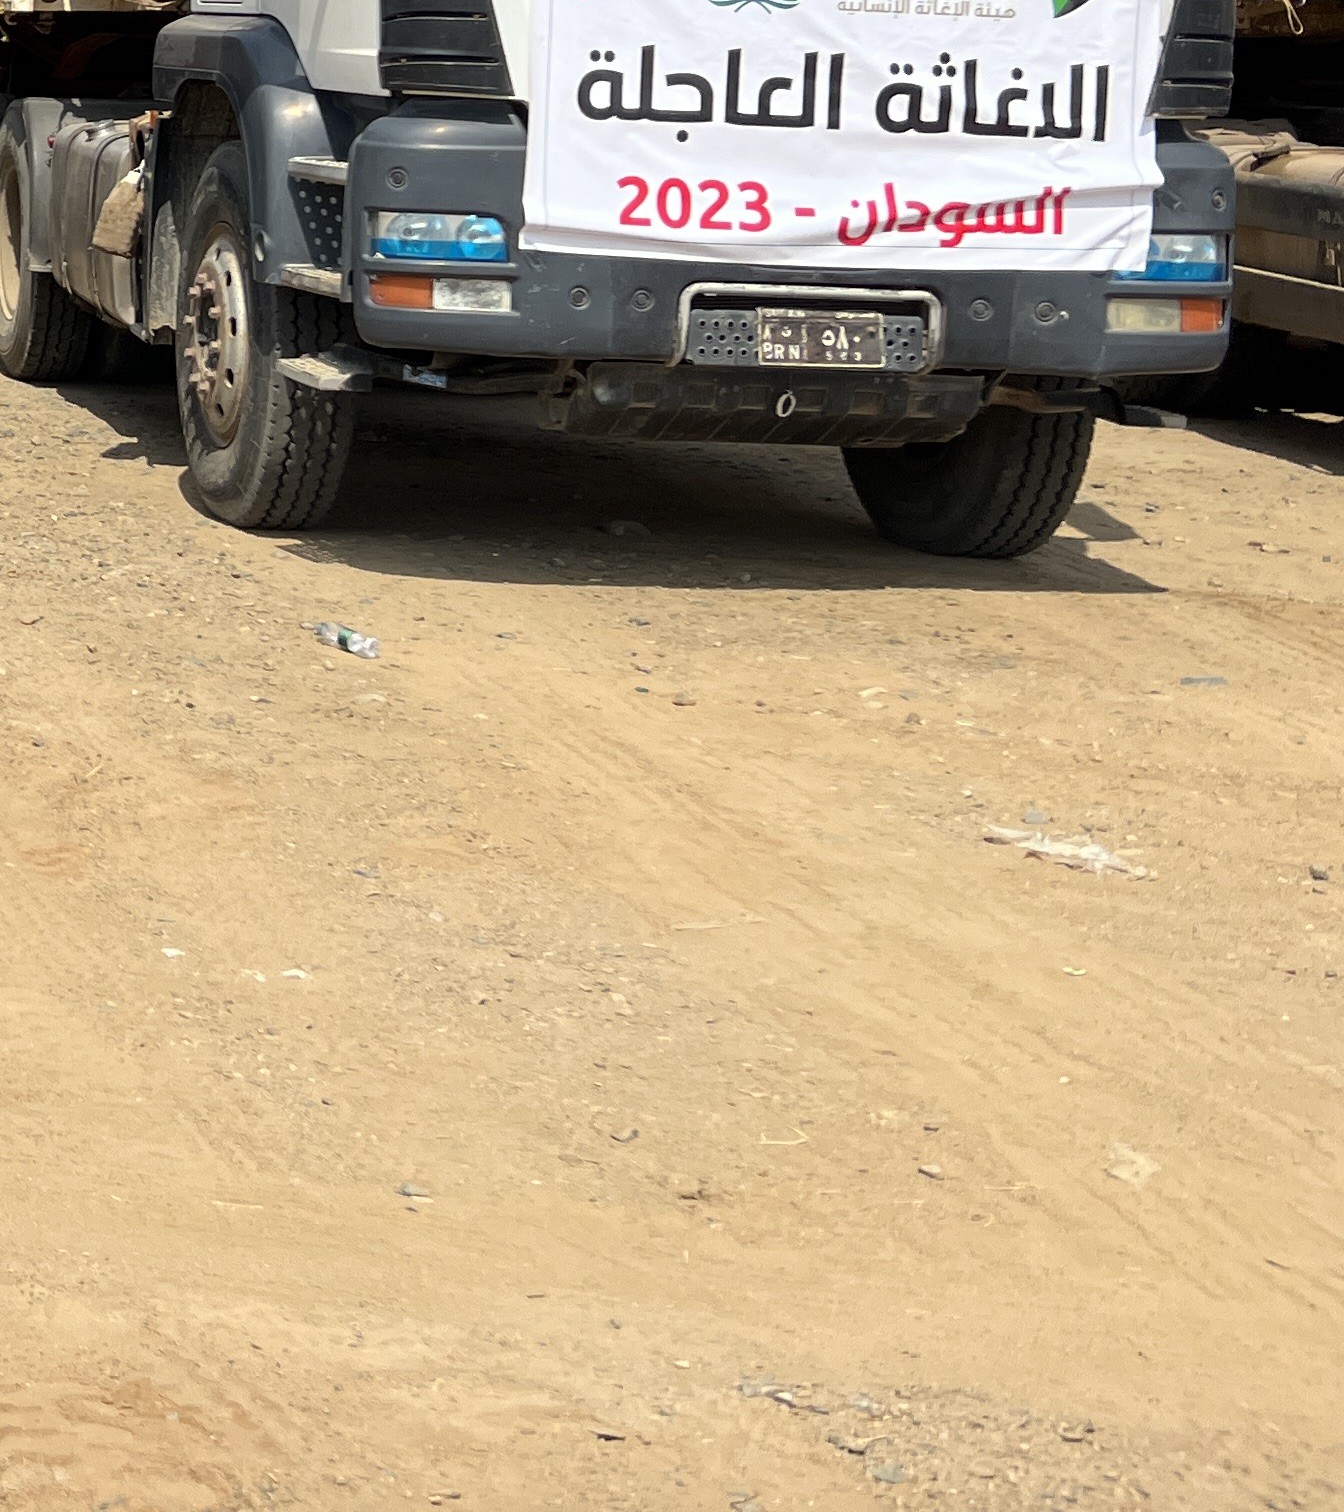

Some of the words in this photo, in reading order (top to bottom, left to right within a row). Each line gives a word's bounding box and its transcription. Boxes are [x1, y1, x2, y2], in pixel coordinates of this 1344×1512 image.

[576, 44, 846, 144] العاجلة
[616, 176, 772, 232] 2023
[837, 182, 1071, 248] السودان
